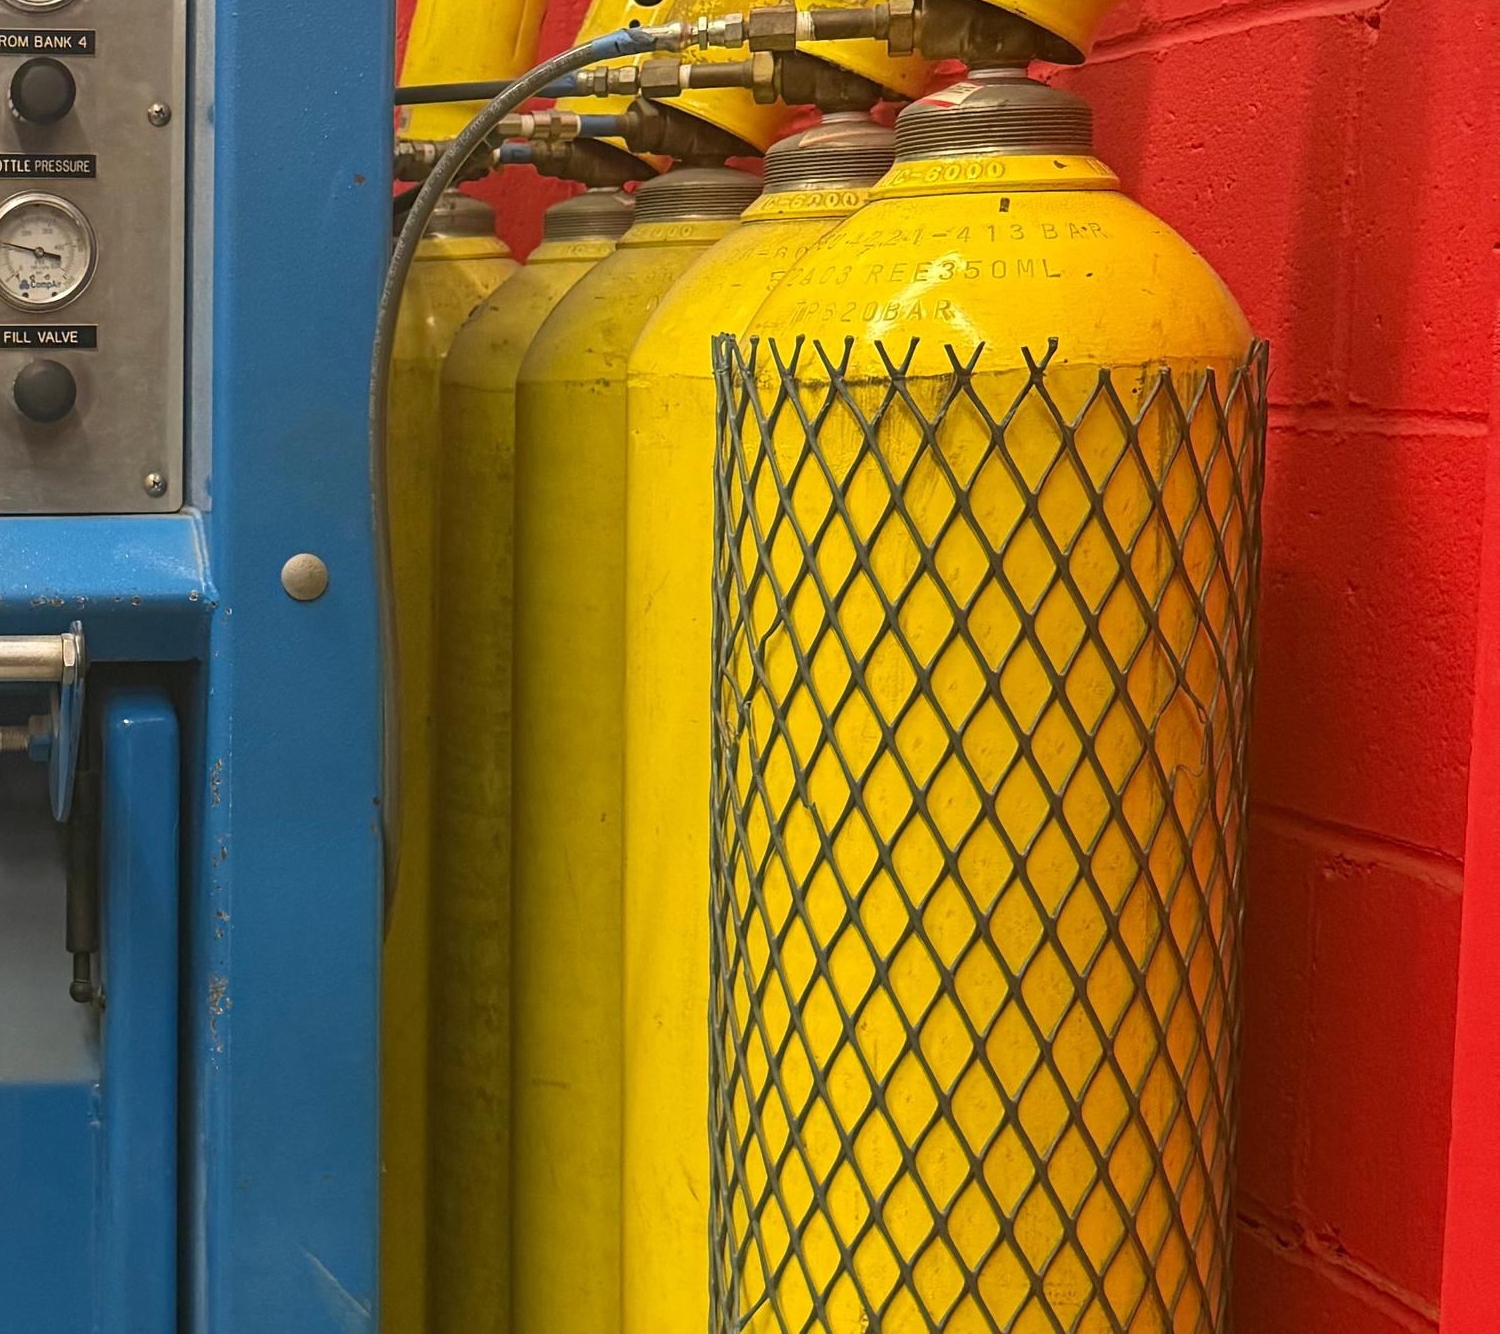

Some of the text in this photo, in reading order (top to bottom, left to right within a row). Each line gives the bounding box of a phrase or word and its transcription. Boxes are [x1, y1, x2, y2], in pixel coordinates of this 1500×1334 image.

[34, 35, 72, 48] BANK
[78, 35, 87, 48] 4
[34, 159, 91, 173] PRESSURE
[3, 330, 79, 344] FILL VALVE
